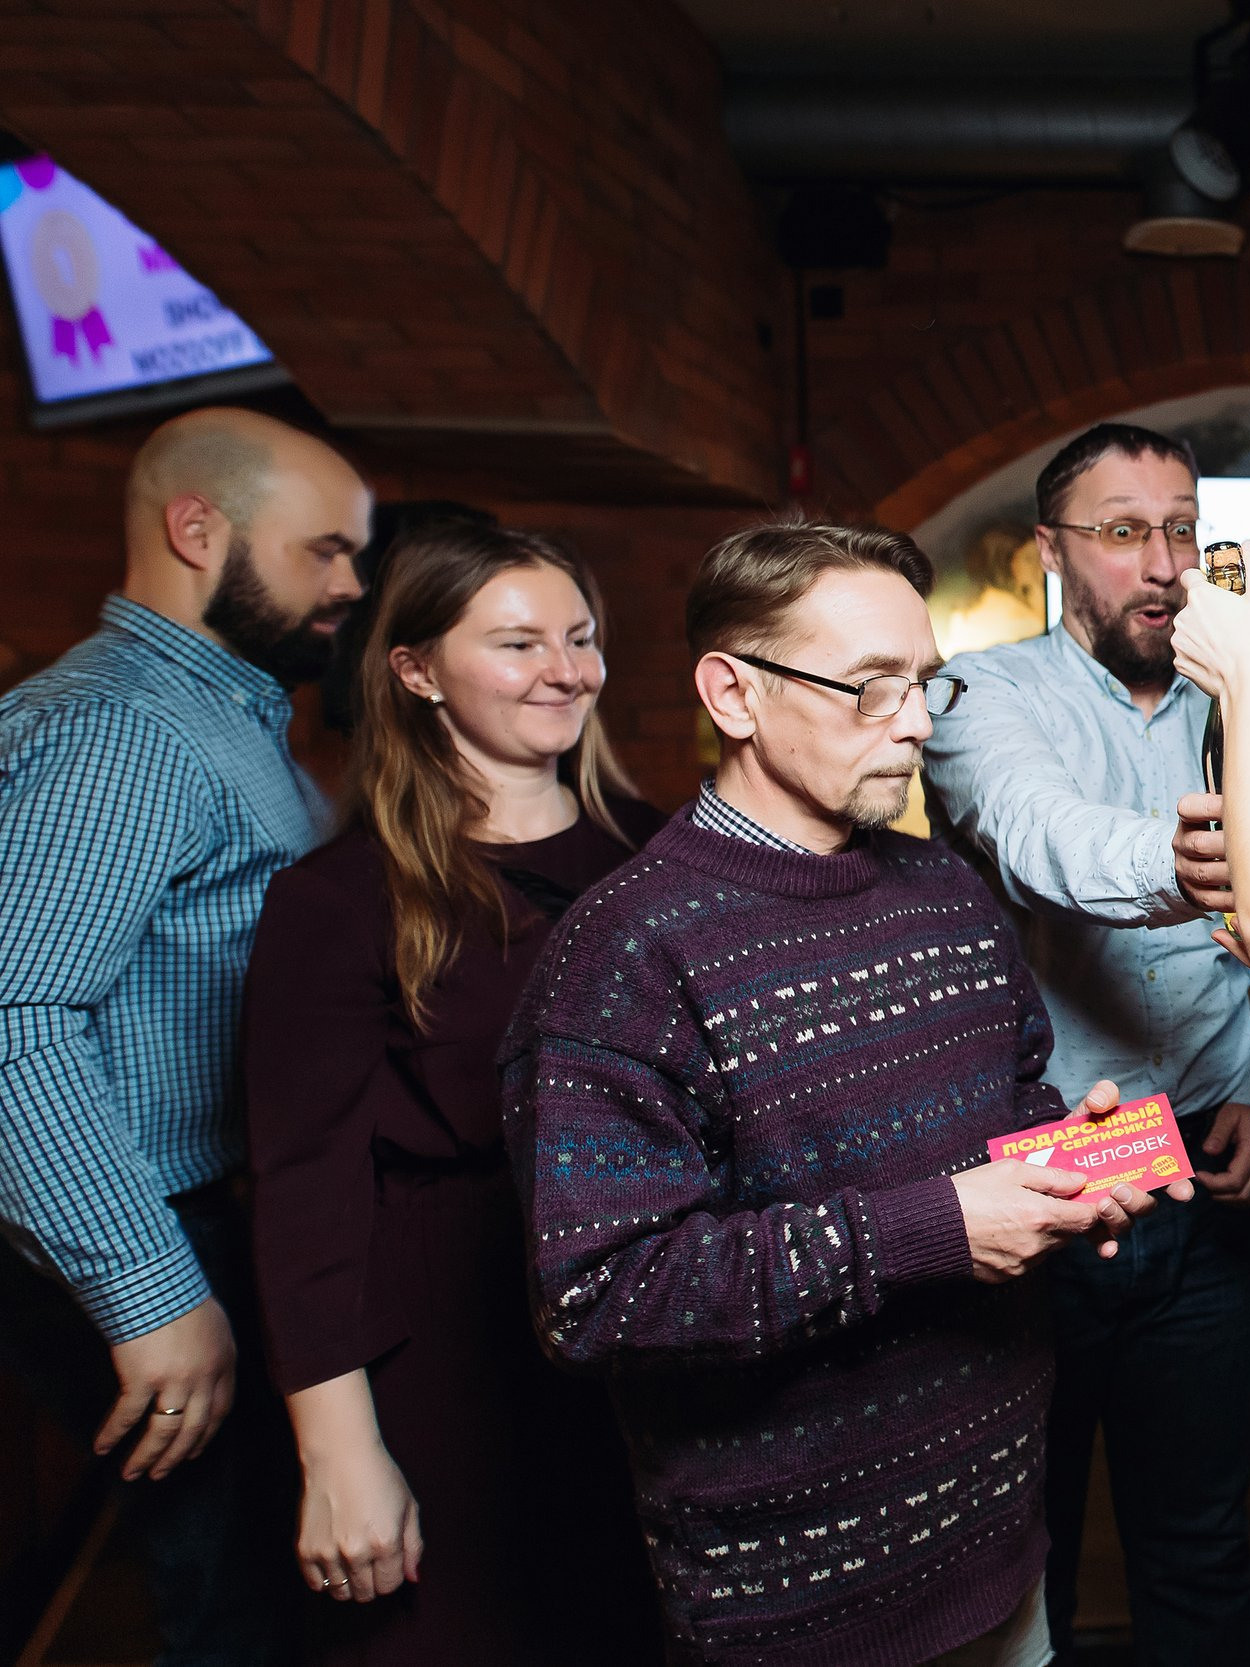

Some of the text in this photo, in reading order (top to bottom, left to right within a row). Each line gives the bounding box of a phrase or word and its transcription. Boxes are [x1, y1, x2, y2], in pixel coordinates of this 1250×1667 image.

[1002, 1102, 1162, 1157] ПОДАРОЧНЫЙ
[1061, 1116, 1164, 1151] СЕРТИФИКАТ
[1074, 1133, 1171, 1169] ЧЕЛОВЕК
